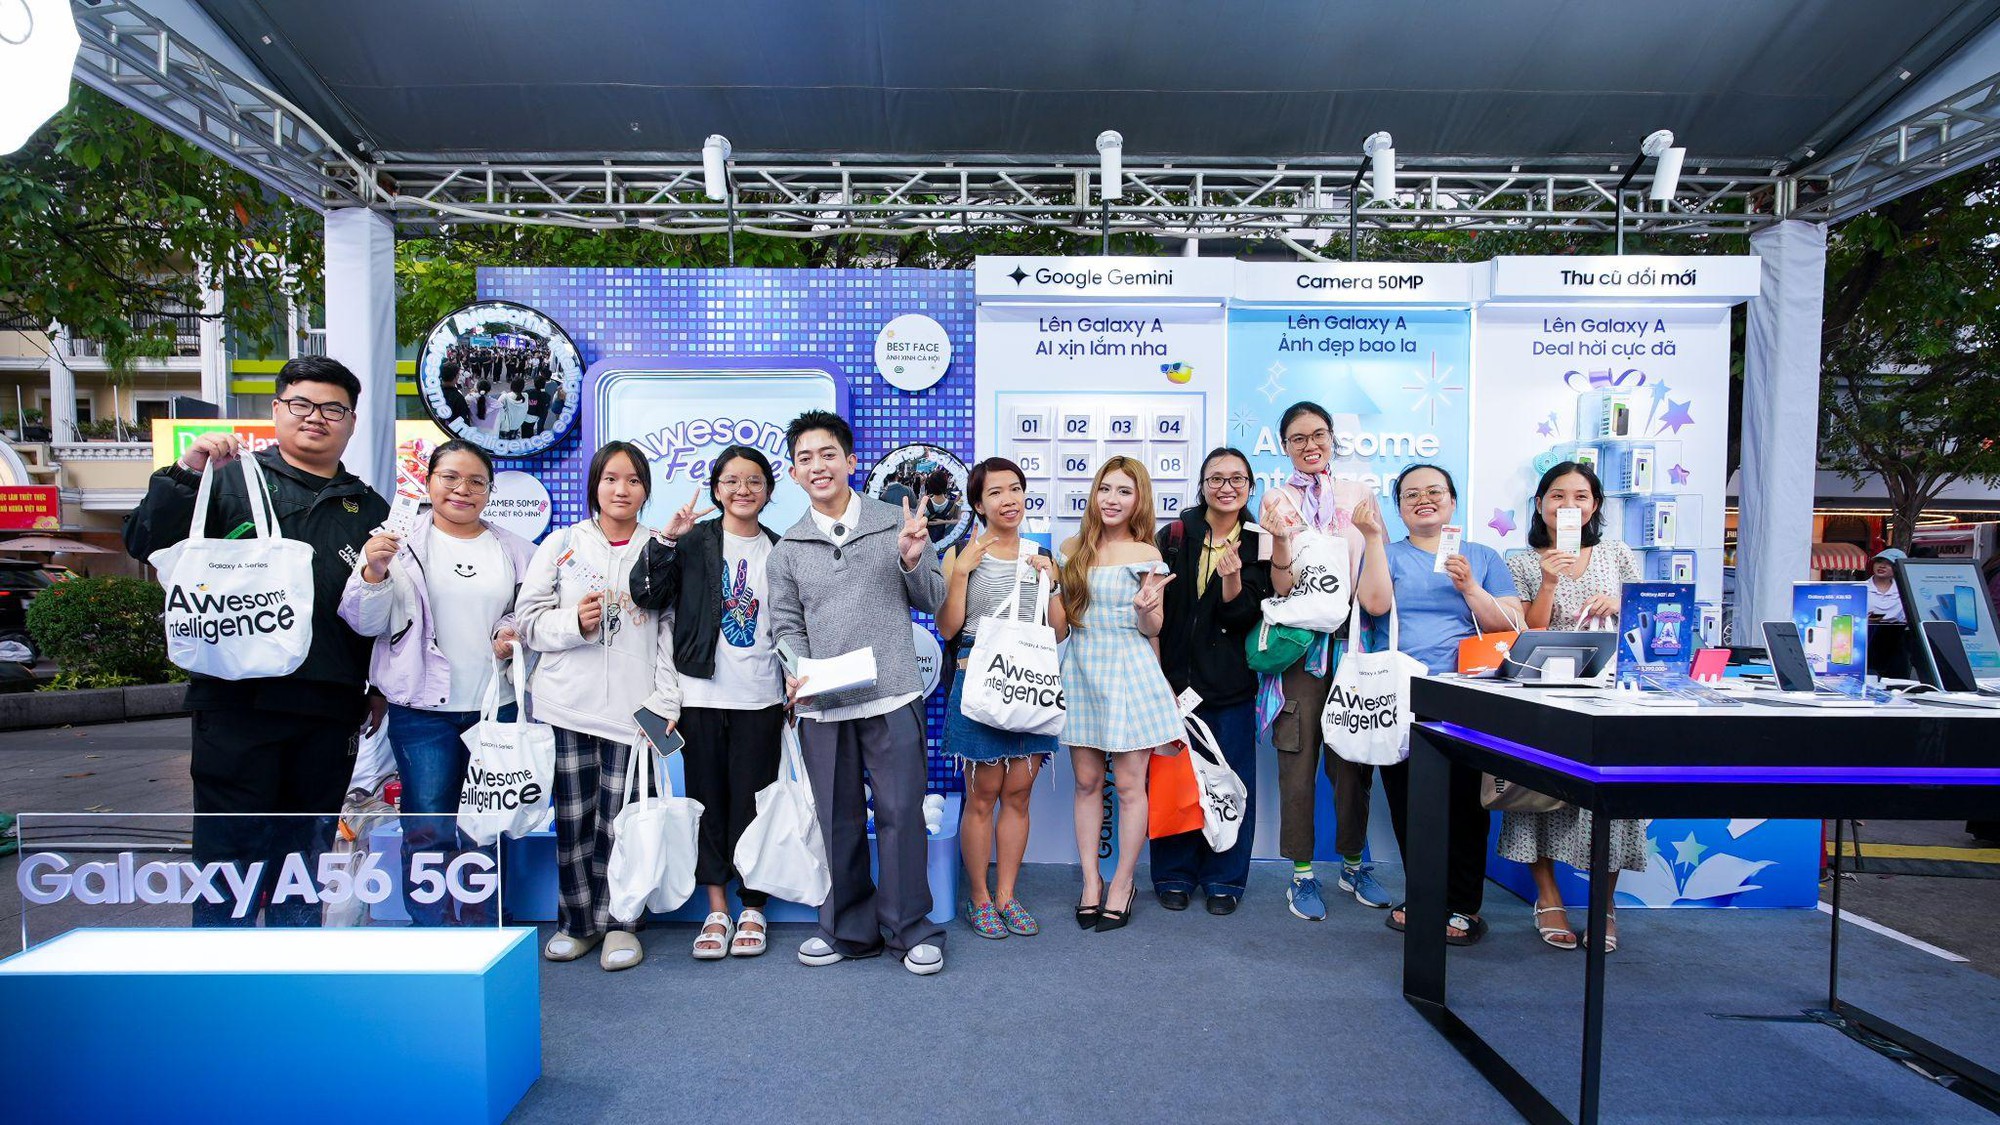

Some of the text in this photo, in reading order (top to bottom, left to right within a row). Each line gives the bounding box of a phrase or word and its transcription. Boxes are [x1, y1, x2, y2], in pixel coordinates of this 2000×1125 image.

[1035, 267, 1173, 289] Google Gemini
[1296, 274, 1424, 289] Camera 50MP
[1560, 269, 1594, 286] Thu
[1599, 269, 1622, 286] cũ
[1660, 269, 1697, 286] mới
[1039, 316, 1164, 337] Lên Galaxy A
[1288, 314, 1407, 334] Lên Galaxy A
[1543, 317, 1666, 338] Lên Galaxy A
[887, 342, 940, 352] BEST FACE
[1035, 336, 1167, 360] AI xịn lắm nha
[1278, 333, 1417, 357] Ảnh đẹp bao la
[1532, 340, 1676, 360] Deal hời cực đã
[1021, 419, 1181, 434] 01 02 03 04
[630, 417, 792, 463] Awesom
[1252, 426, 1441, 458] Asome
[1020, 457, 1181, 472] 05 06 08
[516, 499, 540, 507] 50MP
[1024, 497, 1178, 511] 09 10 12
[208, 561, 236, 571] Galaxy
[245, 561, 268, 569] Series
[167, 584, 286, 614] Awesome
[169, 603, 295, 645] ntelligence
[987, 653, 1061, 686] Awesom
[460, 782, 542, 813] elligence
[1098, 779, 1115, 859] Galaxy
[16, 851, 499, 919] Galaxy A56 5G
